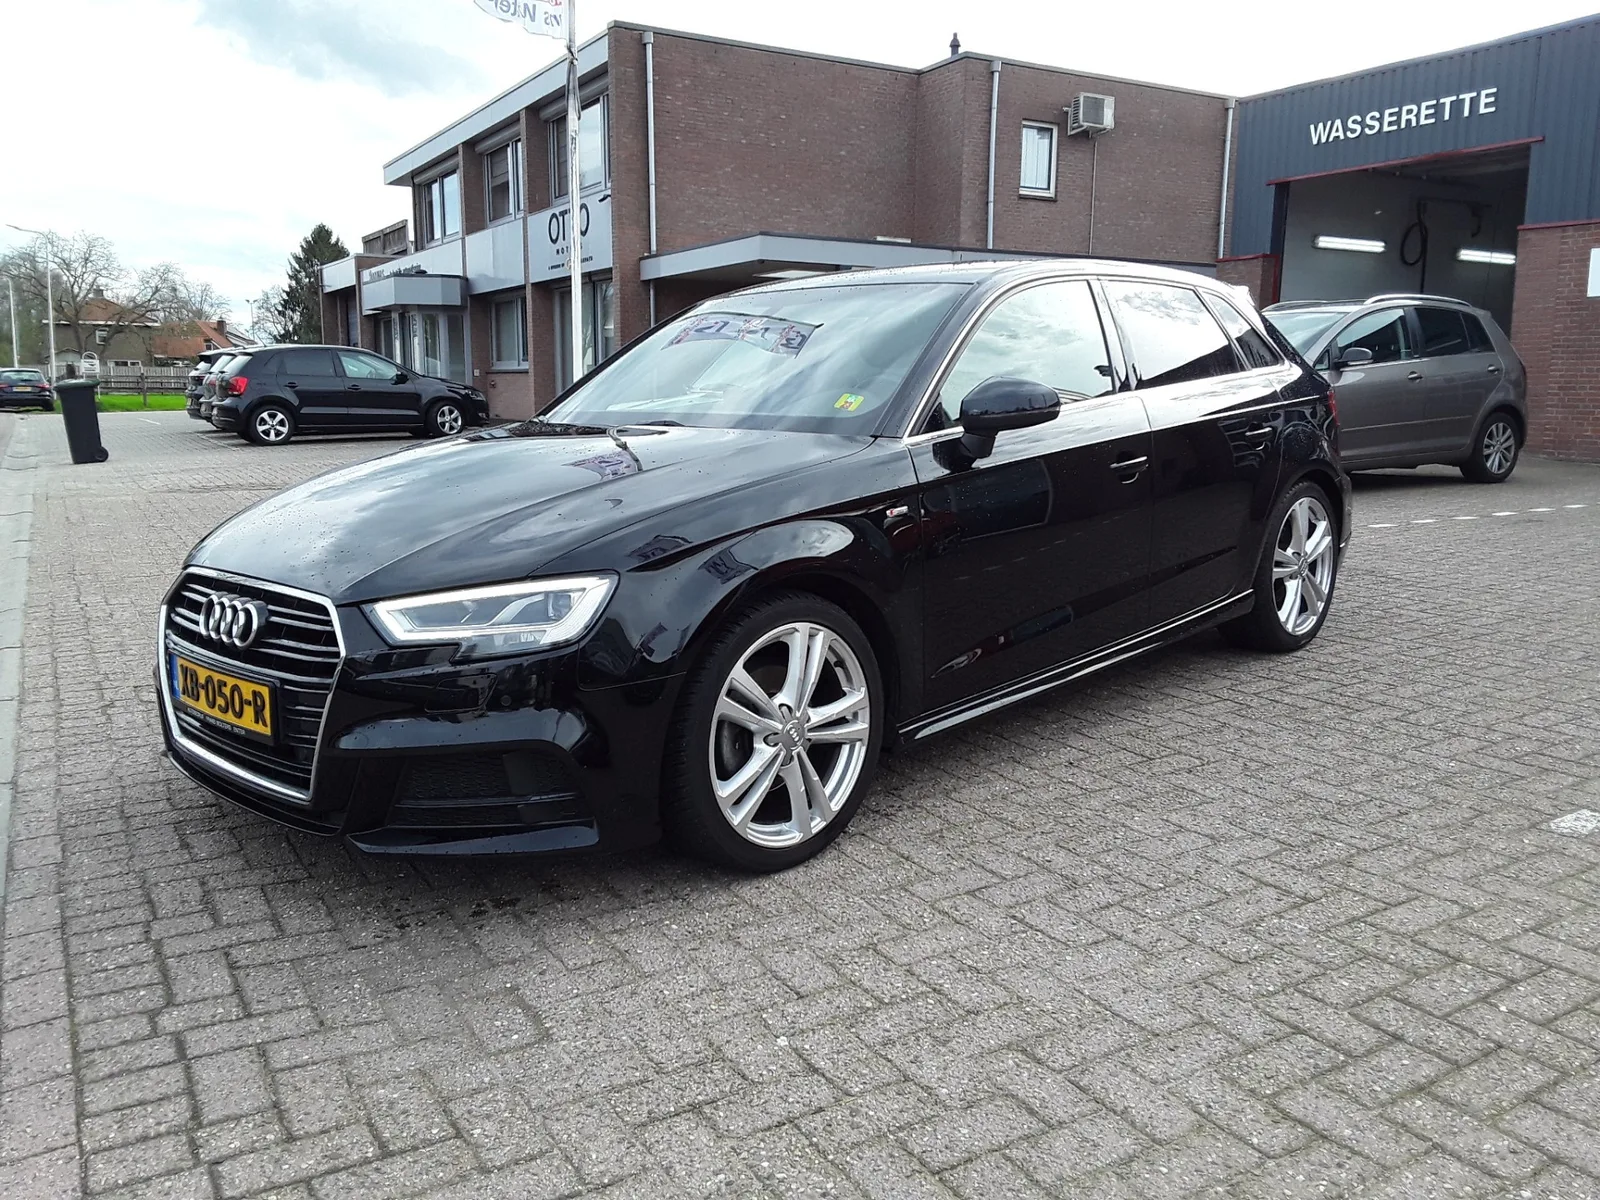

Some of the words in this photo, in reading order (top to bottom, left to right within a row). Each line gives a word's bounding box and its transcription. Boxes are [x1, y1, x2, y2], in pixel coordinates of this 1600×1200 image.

[1310, 88, 1497, 145] WASSERETTE
[548, 203, 589, 245] OTO
[179, 664, 268, 728] XB-050-R
